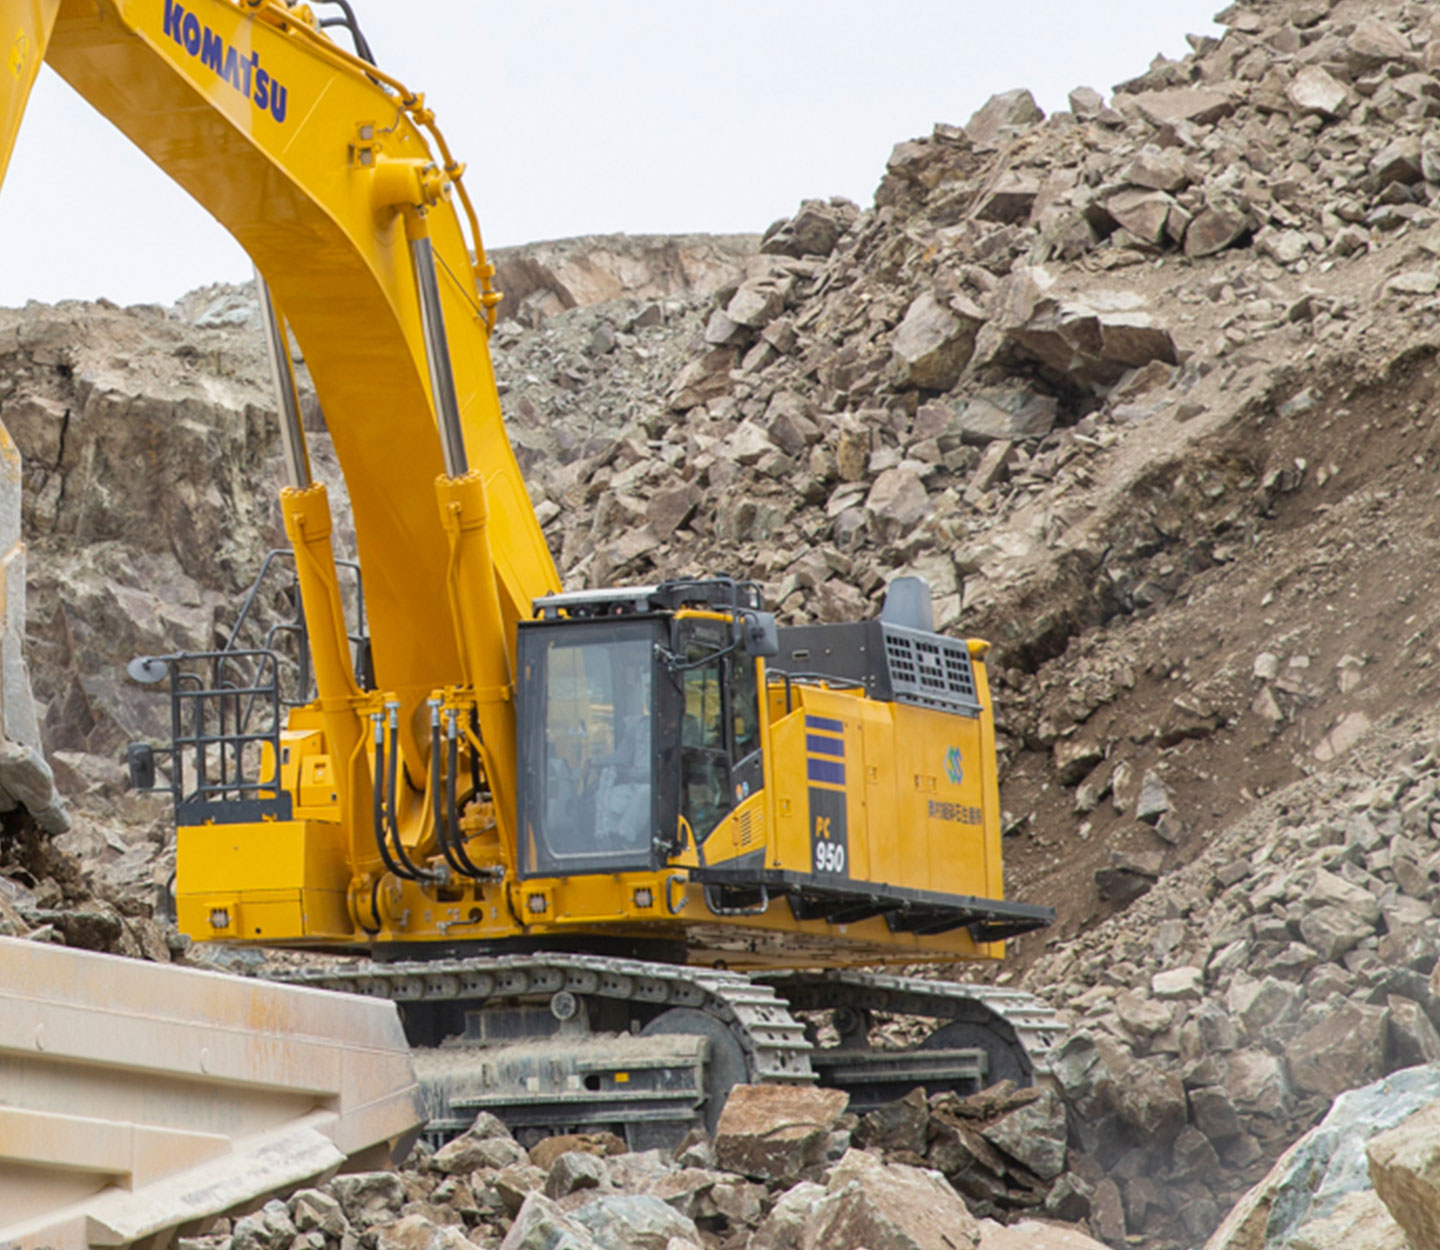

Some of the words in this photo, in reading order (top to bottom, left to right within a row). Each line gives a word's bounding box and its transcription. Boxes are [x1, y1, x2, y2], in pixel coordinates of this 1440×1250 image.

[163, 0, 287, 123] KOMATSU
[815, 815, 831, 840] PC
[815, 841, 845, 873] 950
